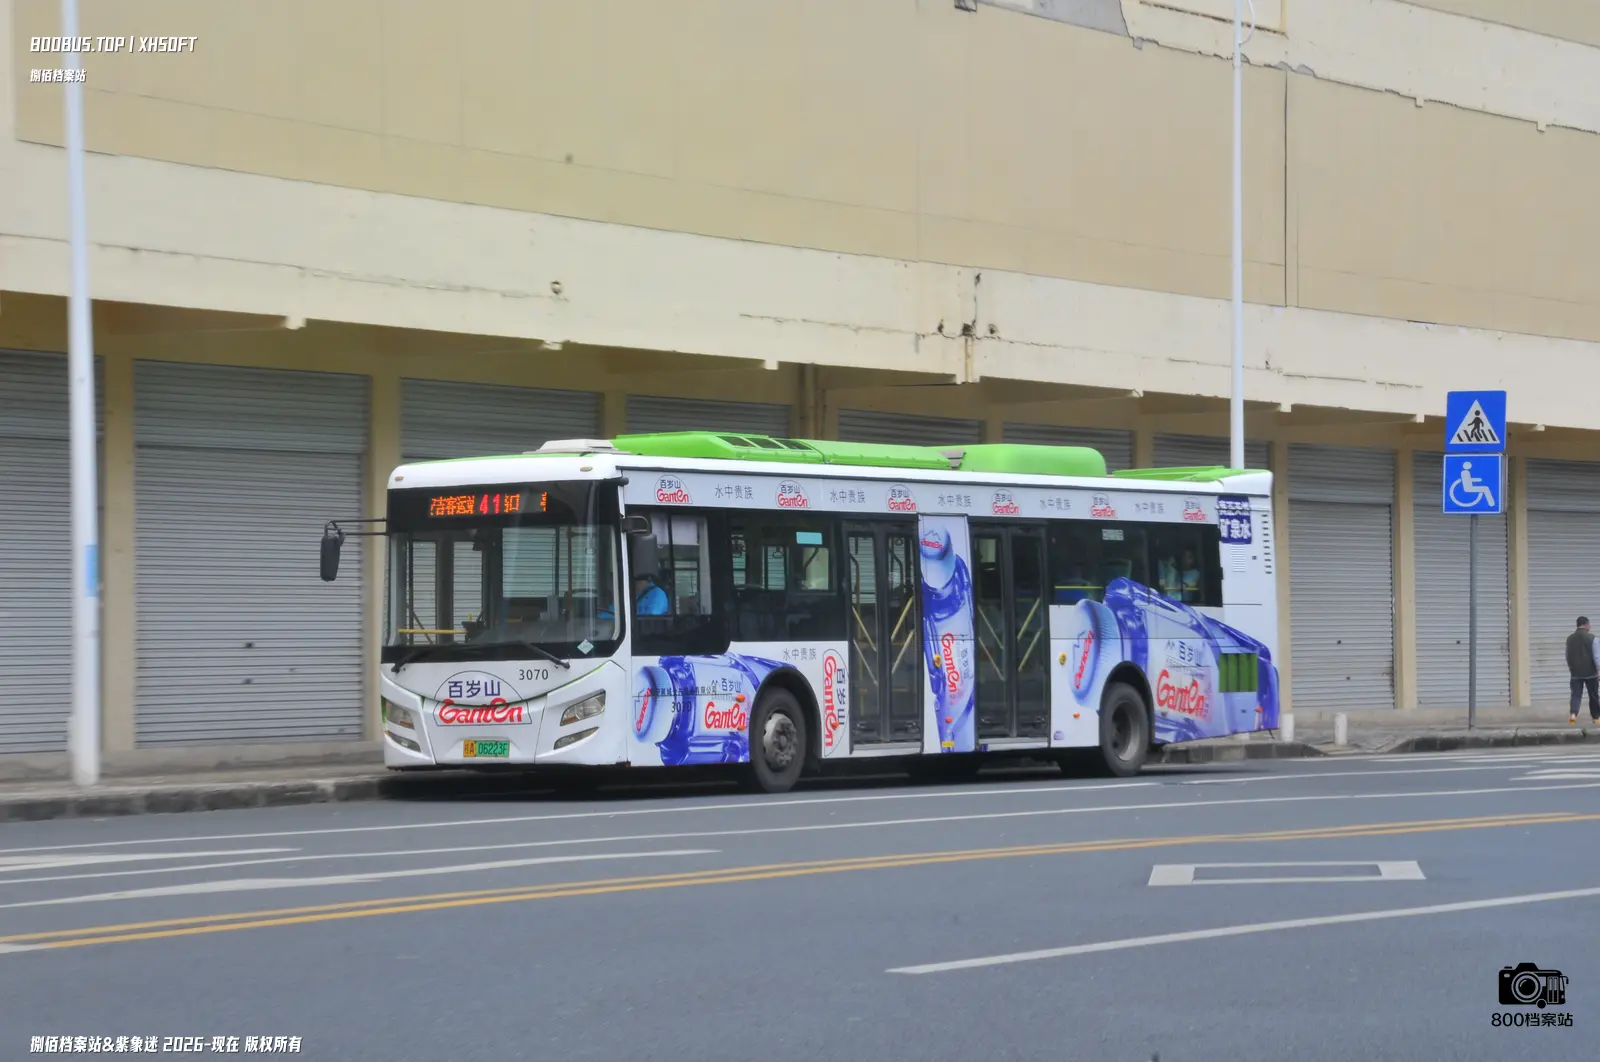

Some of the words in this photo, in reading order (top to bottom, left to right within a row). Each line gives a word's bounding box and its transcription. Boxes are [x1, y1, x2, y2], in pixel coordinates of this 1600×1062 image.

[714, 484, 753, 499] 水中贵族
[480, 493, 500, 515] 41
[783, 648, 817, 661] 水中贵族
[519, 669, 549, 681] 3070
[448, 680, 501, 698] 百岁山
